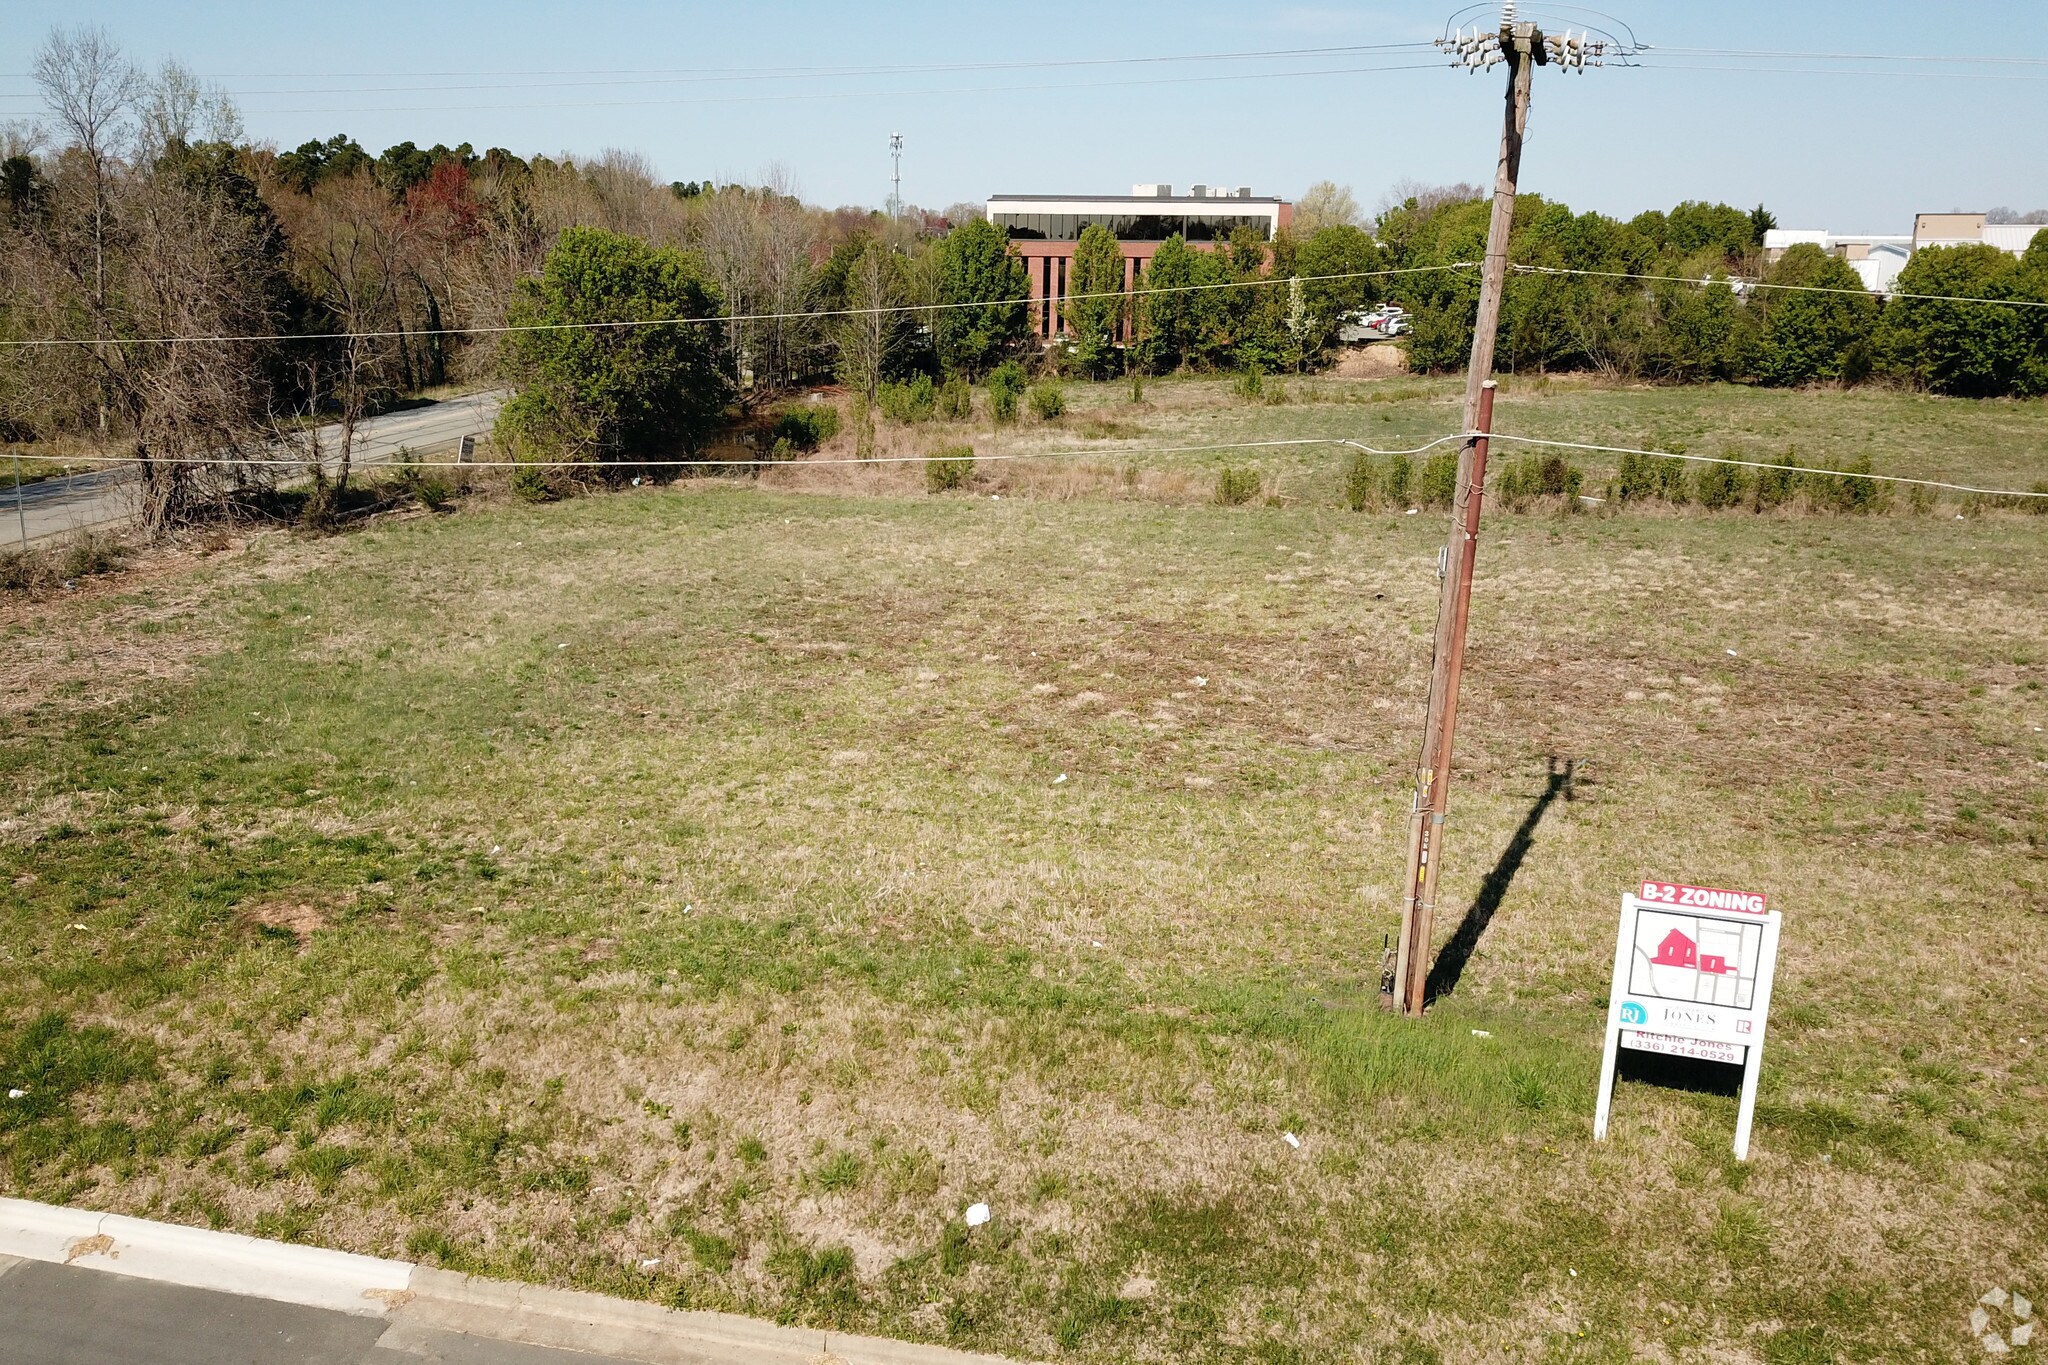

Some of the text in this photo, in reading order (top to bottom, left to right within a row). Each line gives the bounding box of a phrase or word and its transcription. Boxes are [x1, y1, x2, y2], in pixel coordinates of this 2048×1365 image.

[1643, 883, 1763, 913] B-2 ZONING
[1623, 1007, 1640, 1024] RJ
[1664, 1008, 1716, 1025] JONES
[1630, 1039, 1735, 1061] (336) 214-0529
